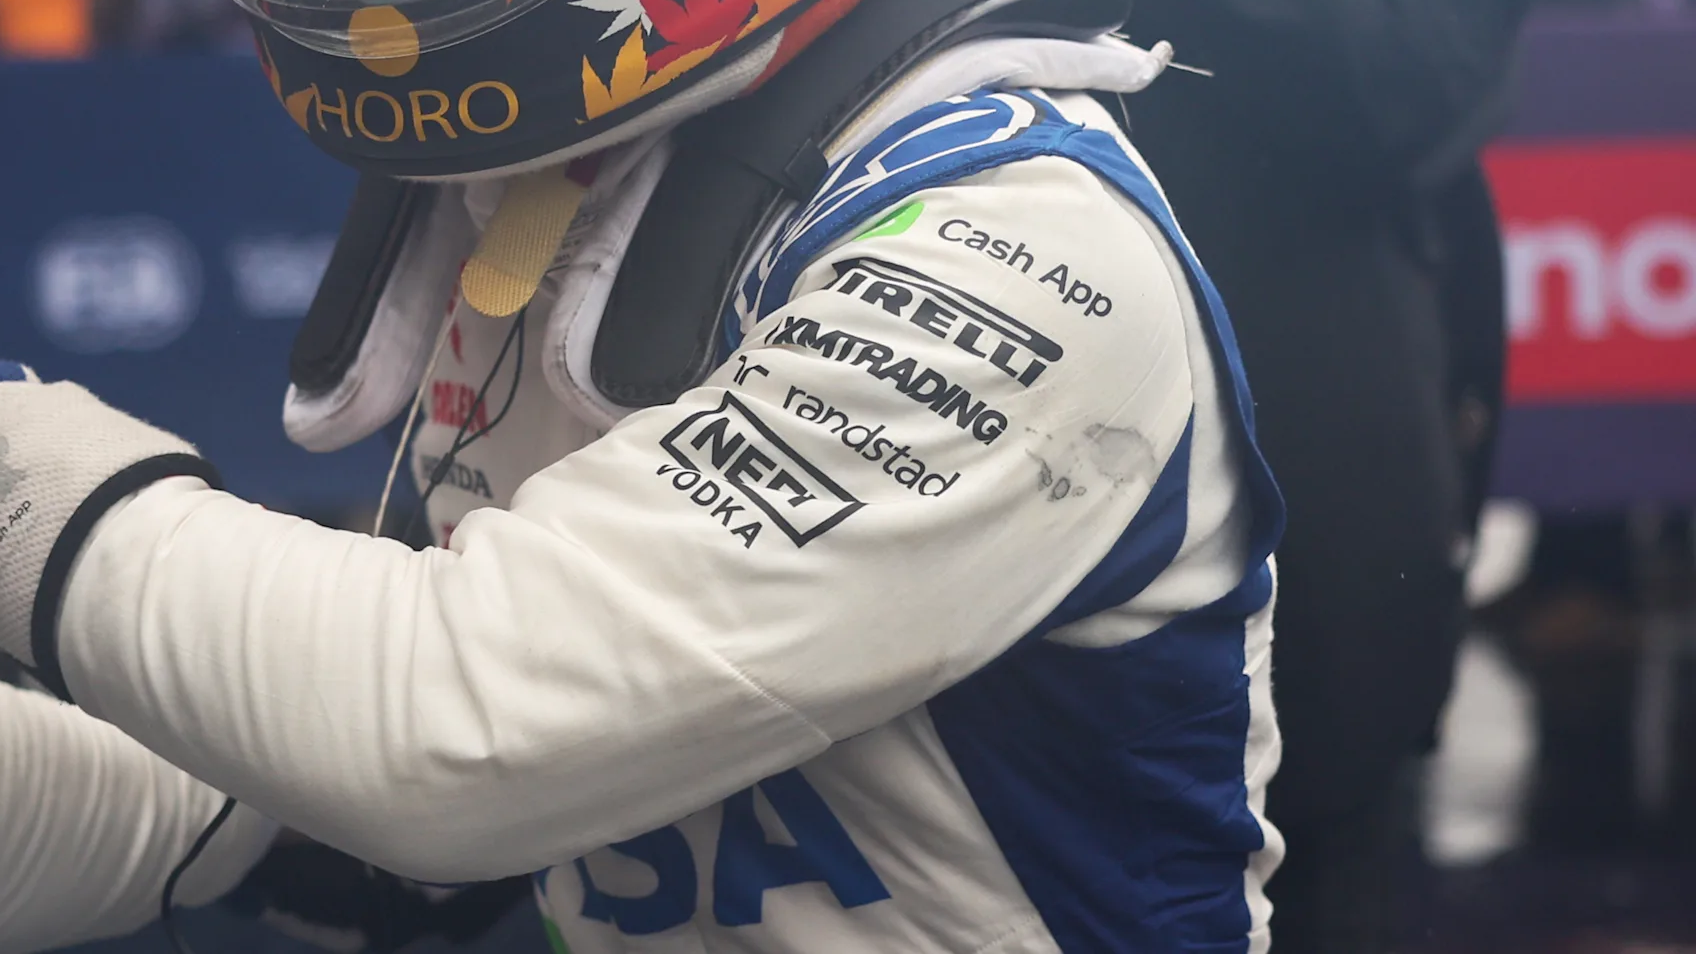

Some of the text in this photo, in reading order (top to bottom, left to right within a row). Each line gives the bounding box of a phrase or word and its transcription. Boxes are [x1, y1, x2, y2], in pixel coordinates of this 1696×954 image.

[310, 80, 519, 142] HORO
[938, 219, 1113, 317] Cash App
[783, 385, 961, 497] randstad
